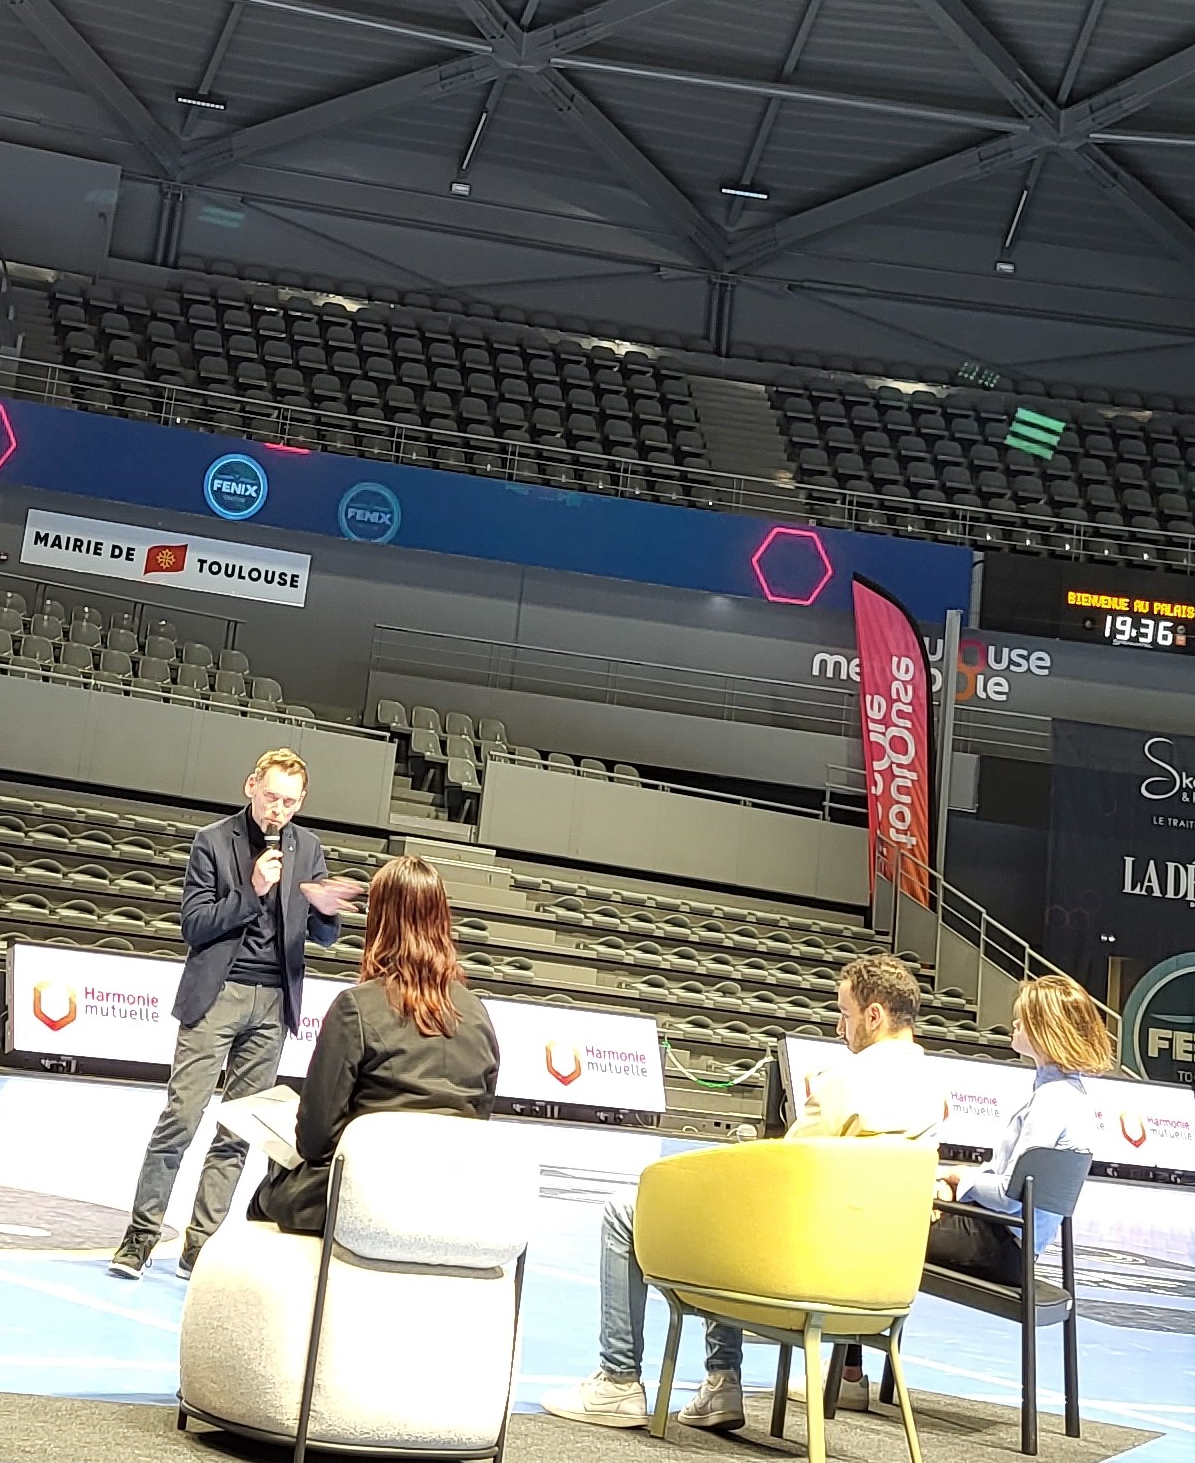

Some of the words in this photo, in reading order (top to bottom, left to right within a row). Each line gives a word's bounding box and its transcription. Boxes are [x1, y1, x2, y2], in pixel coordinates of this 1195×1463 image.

[213, 479, 259, 498] FENIX
[347, 507, 392, 526] FENIX
[33, 531, 104, 557] MAIRIE
[109, 544, 136, 563] DE
[197, 558, 300, 589] TOULOUSE
[1067, 591, 1130, 611] BIENVENUE
[1133, 599, 1150, 614] AU
[1153, 602, 1195, 619] PALAIS
[1140, 737, 1195, 800] Sk
[1152, 816, 1165, 826] LE
[1167, 817, 1195, 829] TRAIT
[84, 987, 159, 1008] Harmonie
[85, 1003, 160, 1023] mutuelle
[585, 1045, 646, 1064] Harmonie
[587, 1061, 648, 1078] mutuelle
[950, 1090, 998, 1107] Harmonie
[953, 1103, 1000, 1118] mutuelle
